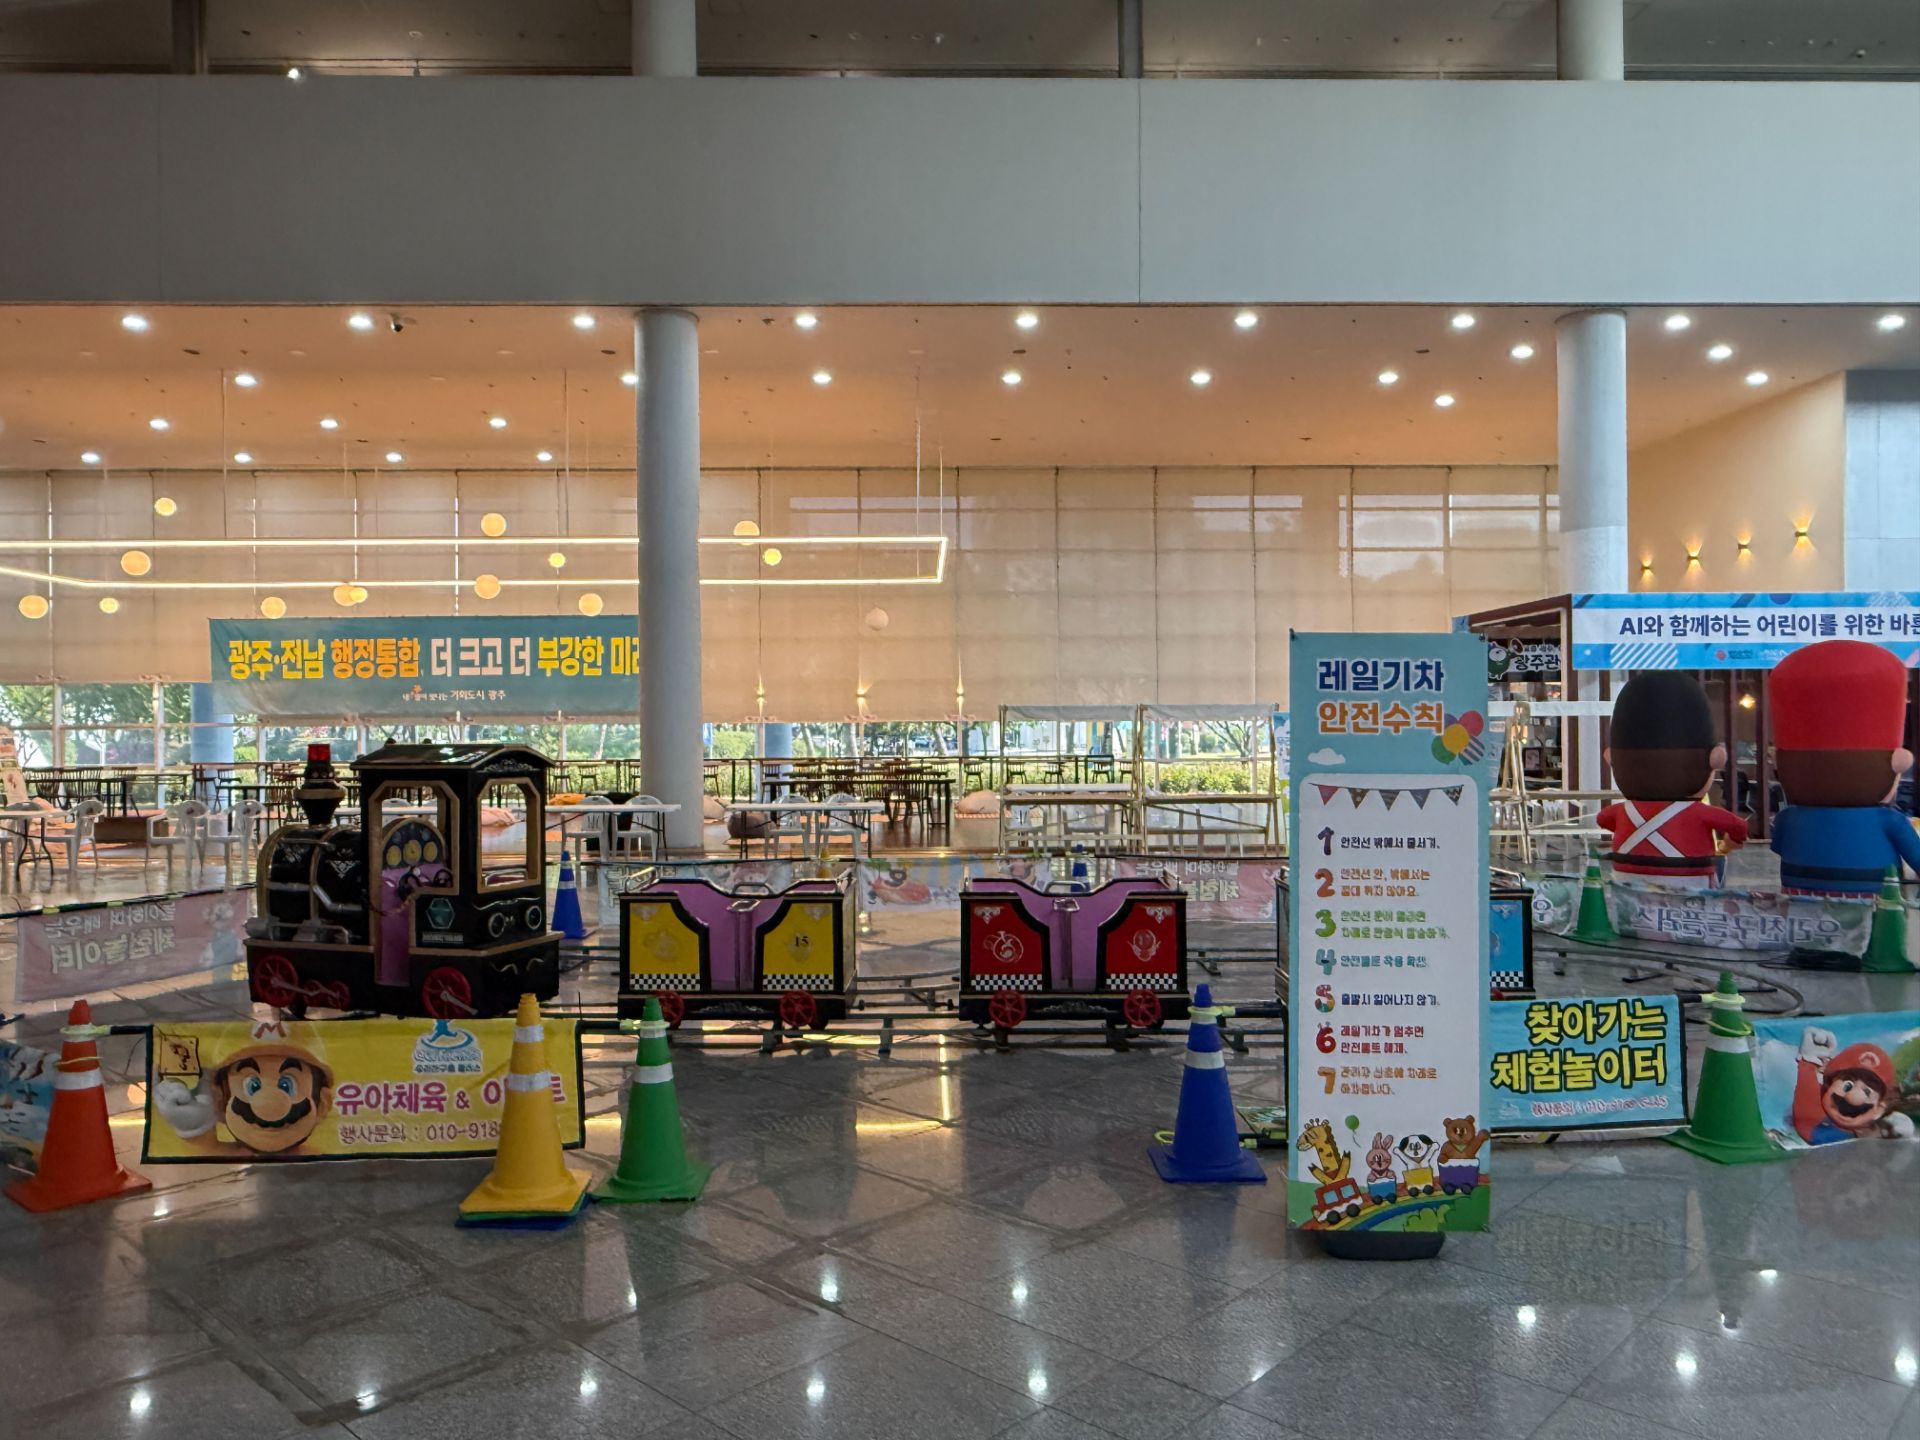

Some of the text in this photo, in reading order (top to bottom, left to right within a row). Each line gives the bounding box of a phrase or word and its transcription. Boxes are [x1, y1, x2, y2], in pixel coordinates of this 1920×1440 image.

[1619, 614, 1664, 637] AI와
[1669, 614, 1752, 637] 함께하는
[1756, 613, 1839, 637] 어린이를
[1843, 613, 1885, 636] 위한
[430, 637, 452, 677] 더
[459, 637, 503, 677] 크고
[510, 636, 531, 677] 더
[537, 635, 604, 677] 부강한
[1317, 659, 1445, 692] 레일기차
[1317, 702, 1445, 735] 안전수칙
[1317, 826, 1335, 856] 1
[1340, 836, 1371, 849] 안전선
[1314, 867, 1336, 898] 2
[1314, 908, 1337, 938] 3
[1315, 948, 1337, 976] 4
[1314, 984, 1336, 1013] 5
[1525, 999, 1668, 1045] 찾아가는
[1315, 1023, 1337, 1054] 6
[1317, 1066, 1336, 1095] 7
[1490, 1044, 1668, 1093] 체험놀이터
[335, 1080, 448, 1116] 유아체육
[454, 1089, 471, 1110] &
